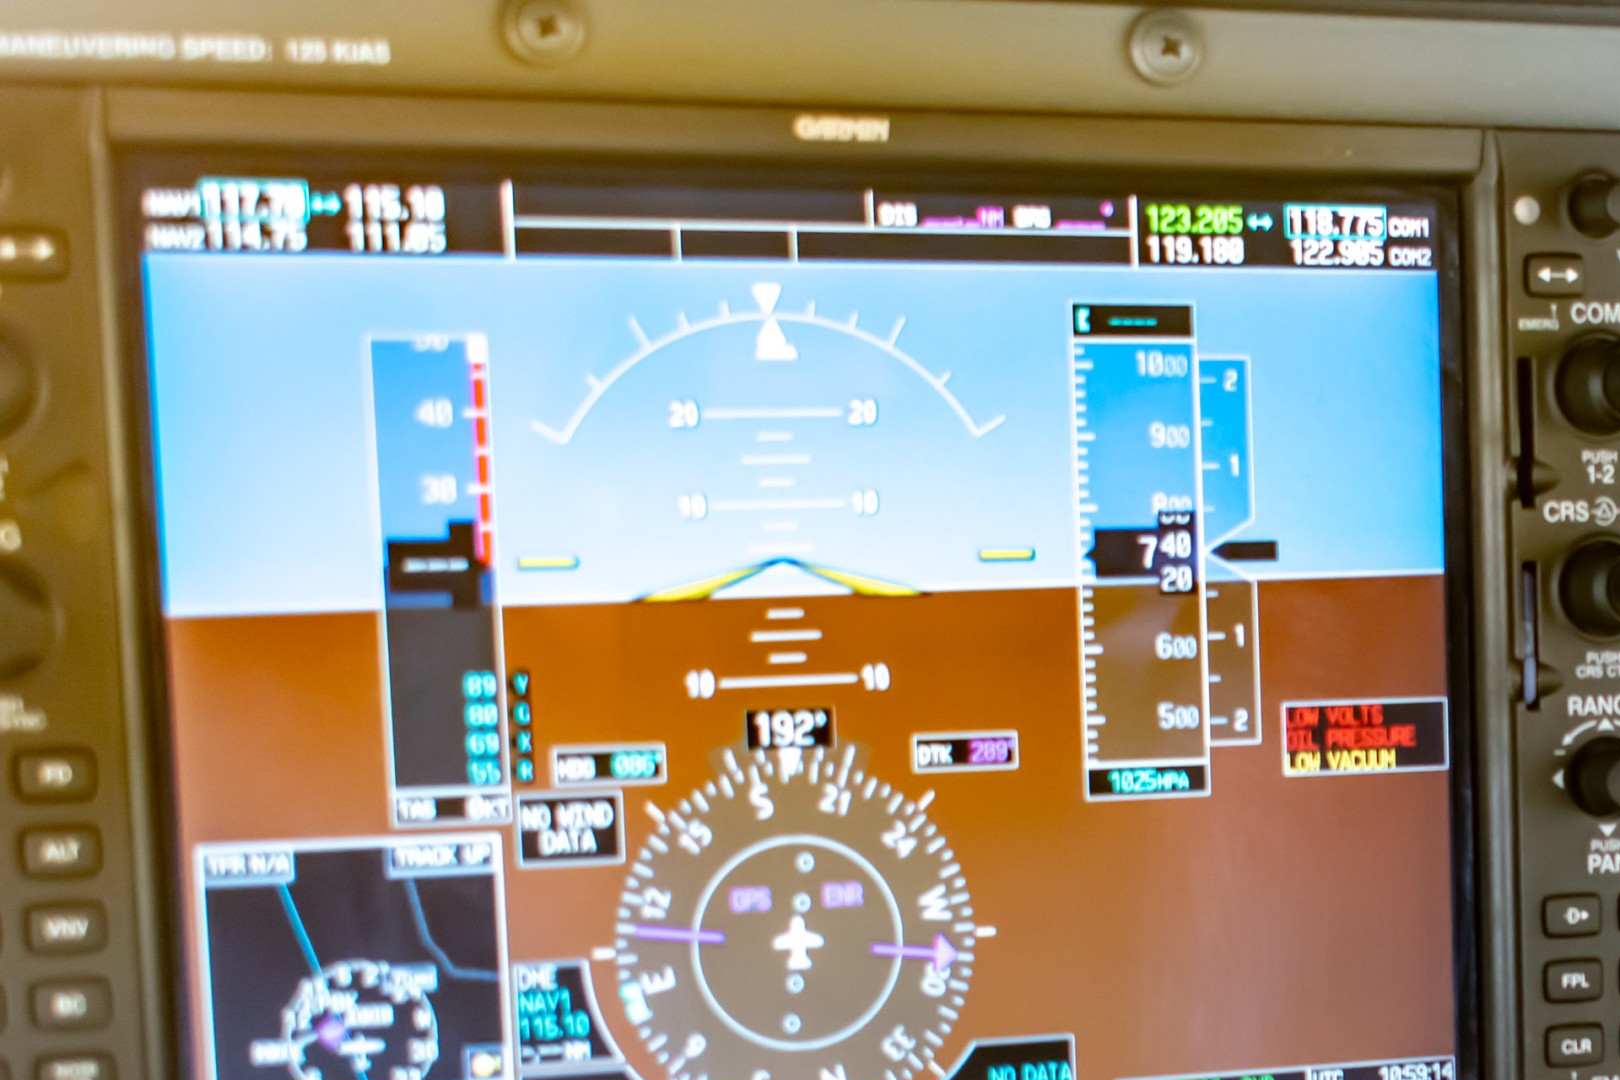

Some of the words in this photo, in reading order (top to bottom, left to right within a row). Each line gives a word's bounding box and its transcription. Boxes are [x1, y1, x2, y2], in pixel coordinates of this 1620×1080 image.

[1148, 422, 1190, 448] 900
[1587, 464, 1615, 484] 1-2
[1543, 501, 1590, 523] CRS
[1155, 632, 1198, 660] 600
[1157, 701, 1200, 730] 500
